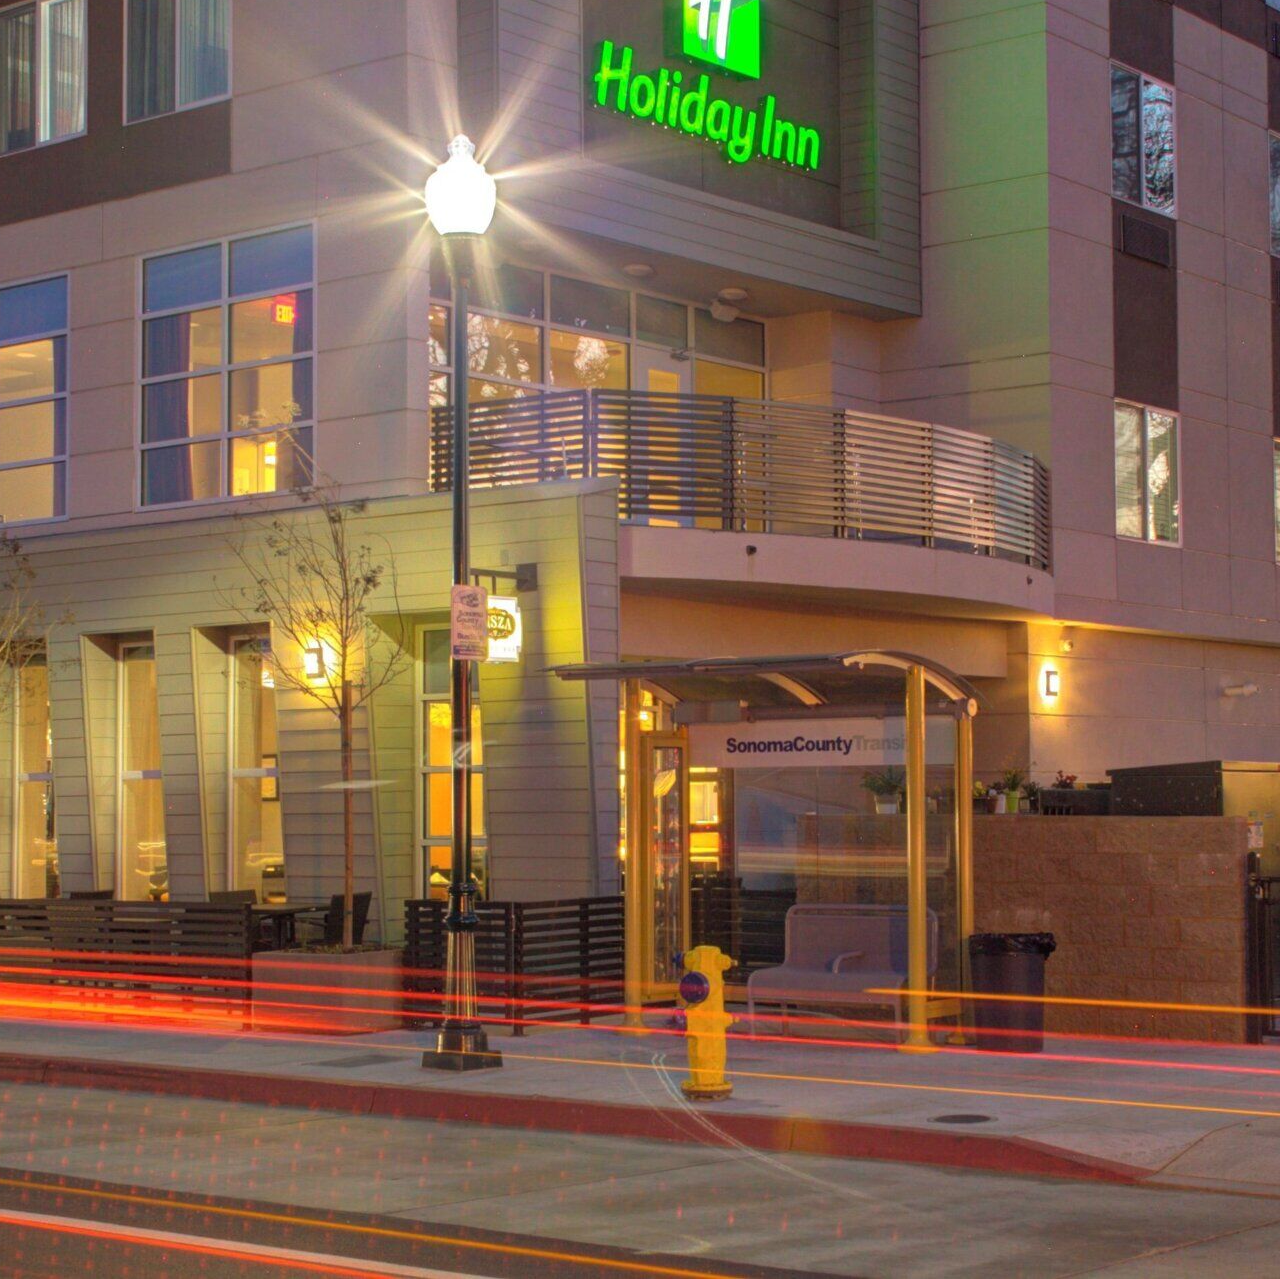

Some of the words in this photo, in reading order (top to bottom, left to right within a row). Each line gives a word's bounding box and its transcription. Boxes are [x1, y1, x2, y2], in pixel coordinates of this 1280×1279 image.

[594, 40, 757, 163] Holiday
[761, 95, 820, 170] Inn
[852, 734, 906, 751] Transi
